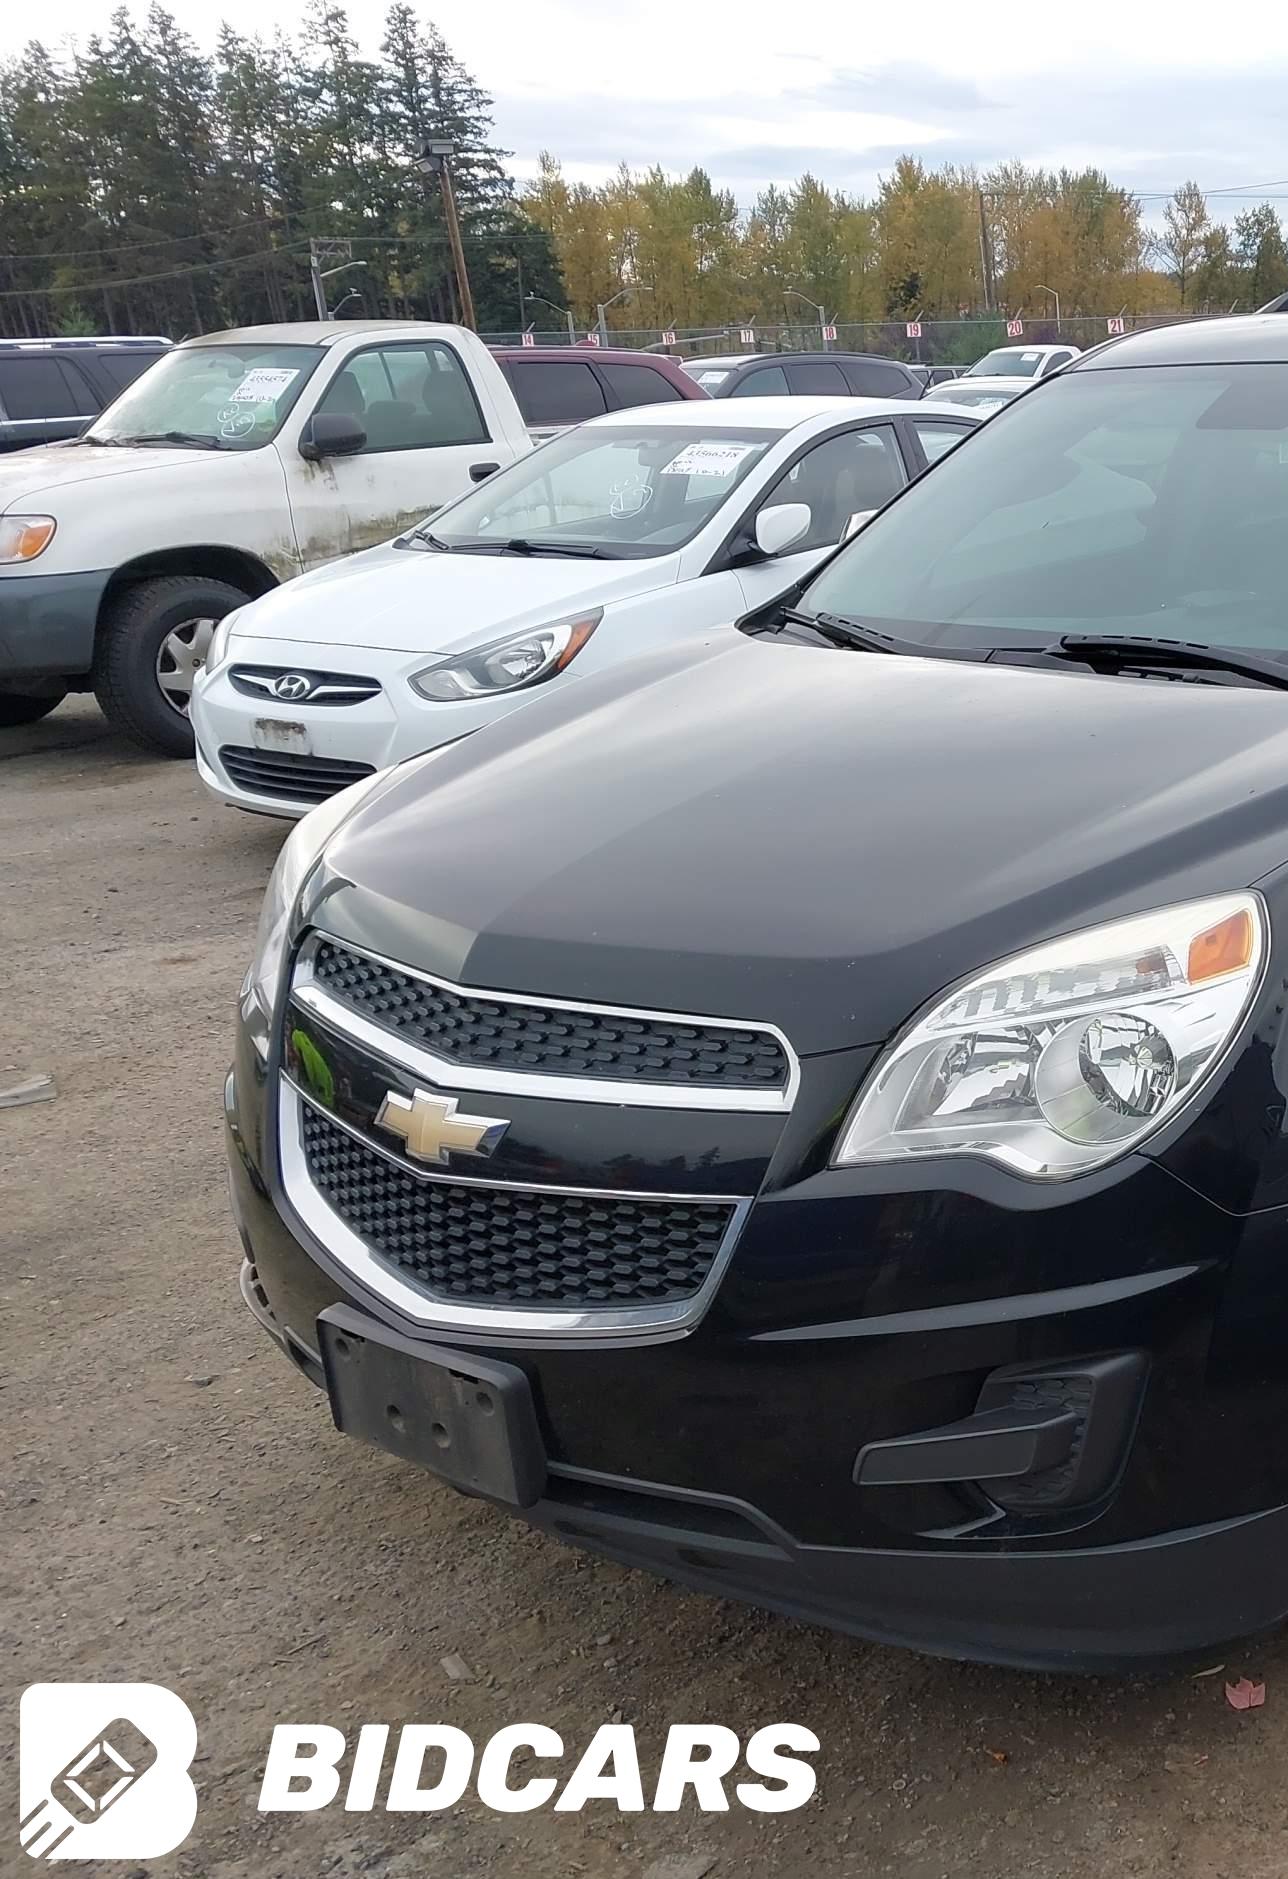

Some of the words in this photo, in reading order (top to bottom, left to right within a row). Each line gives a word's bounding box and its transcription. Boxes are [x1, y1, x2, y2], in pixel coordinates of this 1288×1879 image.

[908, 323, 920, 337] 19
[1007, 321, 1022, 336] 20
[1110, 319, 1122, 333] 21
[664, 333, 673, 344] 16
[744, 330, 753, 342] 17
[825, 327, 835, 339] 18
[523, 334, 533, 345] 14
